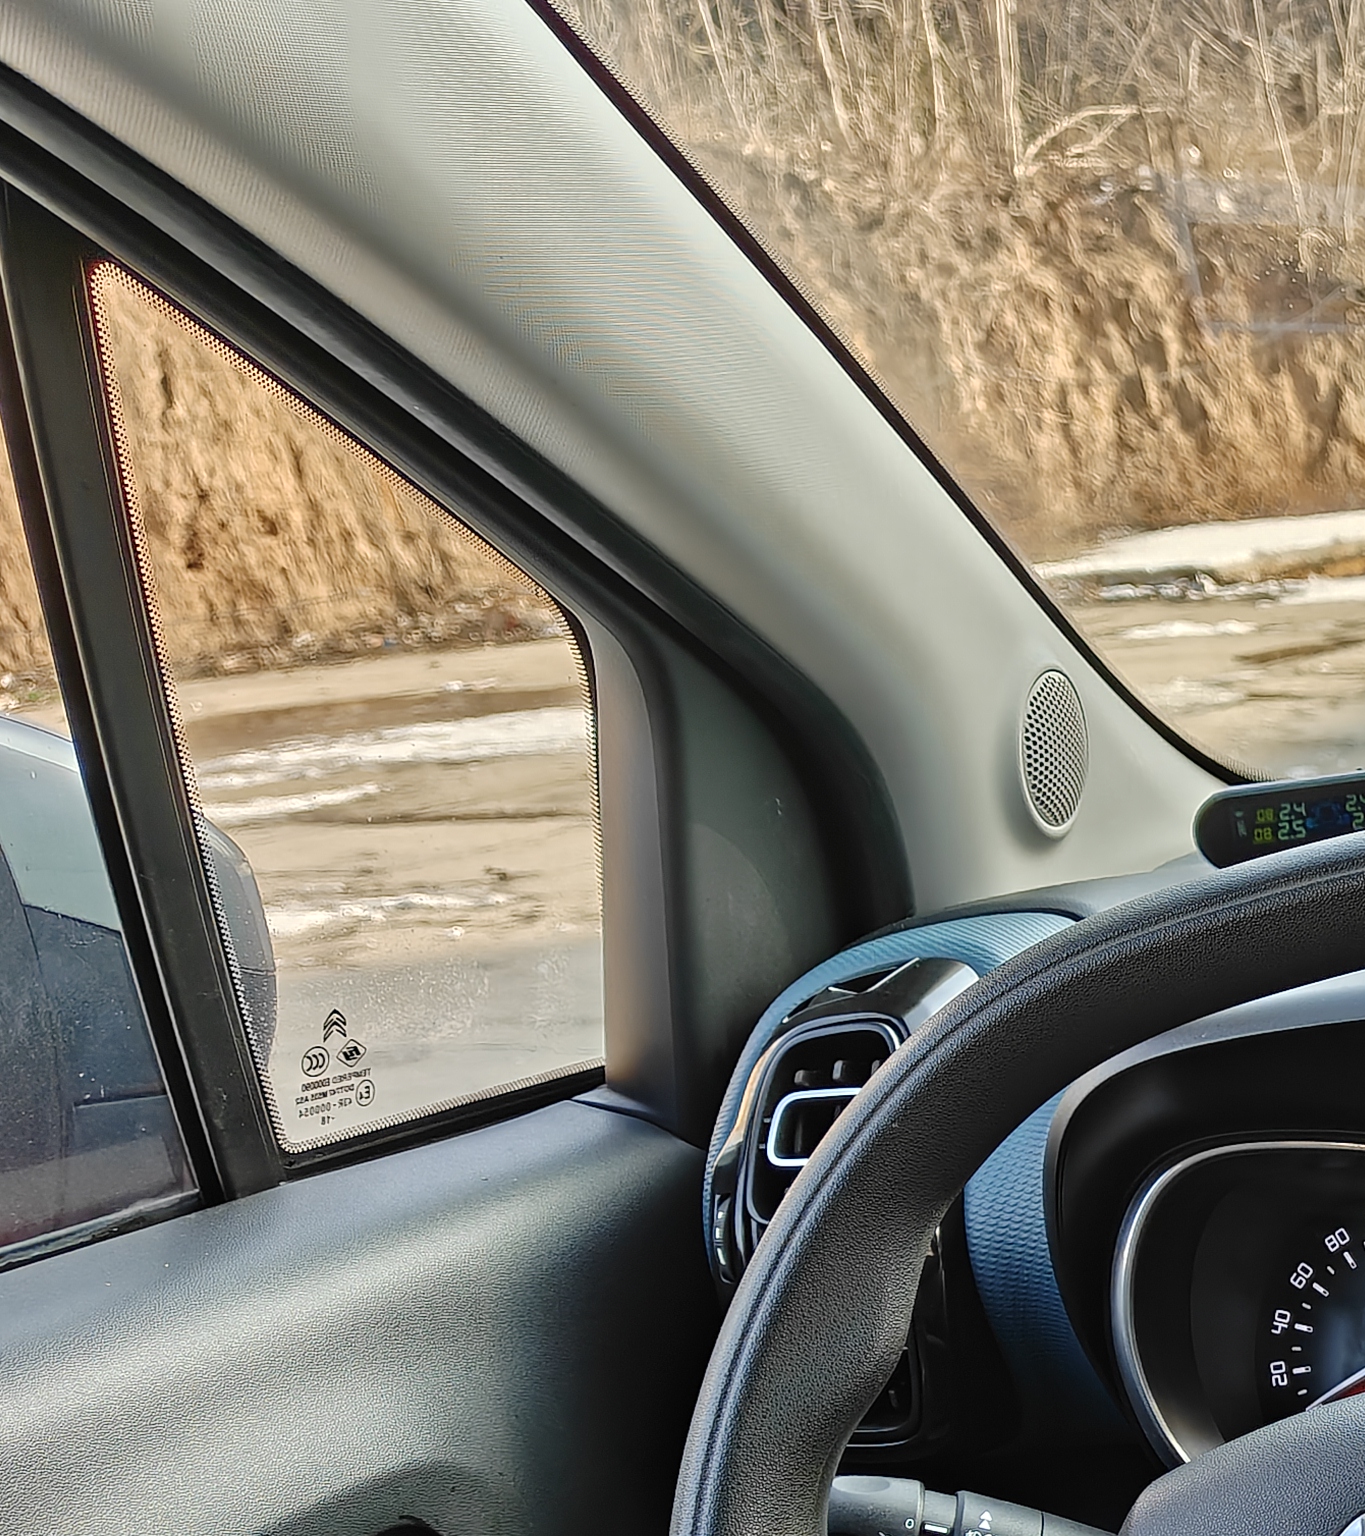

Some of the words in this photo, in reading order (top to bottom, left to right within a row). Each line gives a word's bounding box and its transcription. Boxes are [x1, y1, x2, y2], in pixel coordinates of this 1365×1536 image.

[1278, 802, 1307, 822] 2.4
[1277, 819, 1307, 841] 2.5
[1324, 1227, 1351, 1253] 80
[1289, 1262, 1314, 1290] 60
[1271, 1309, 1291, 1335] 40
[1269, 1361, 1288, 1387] 20
